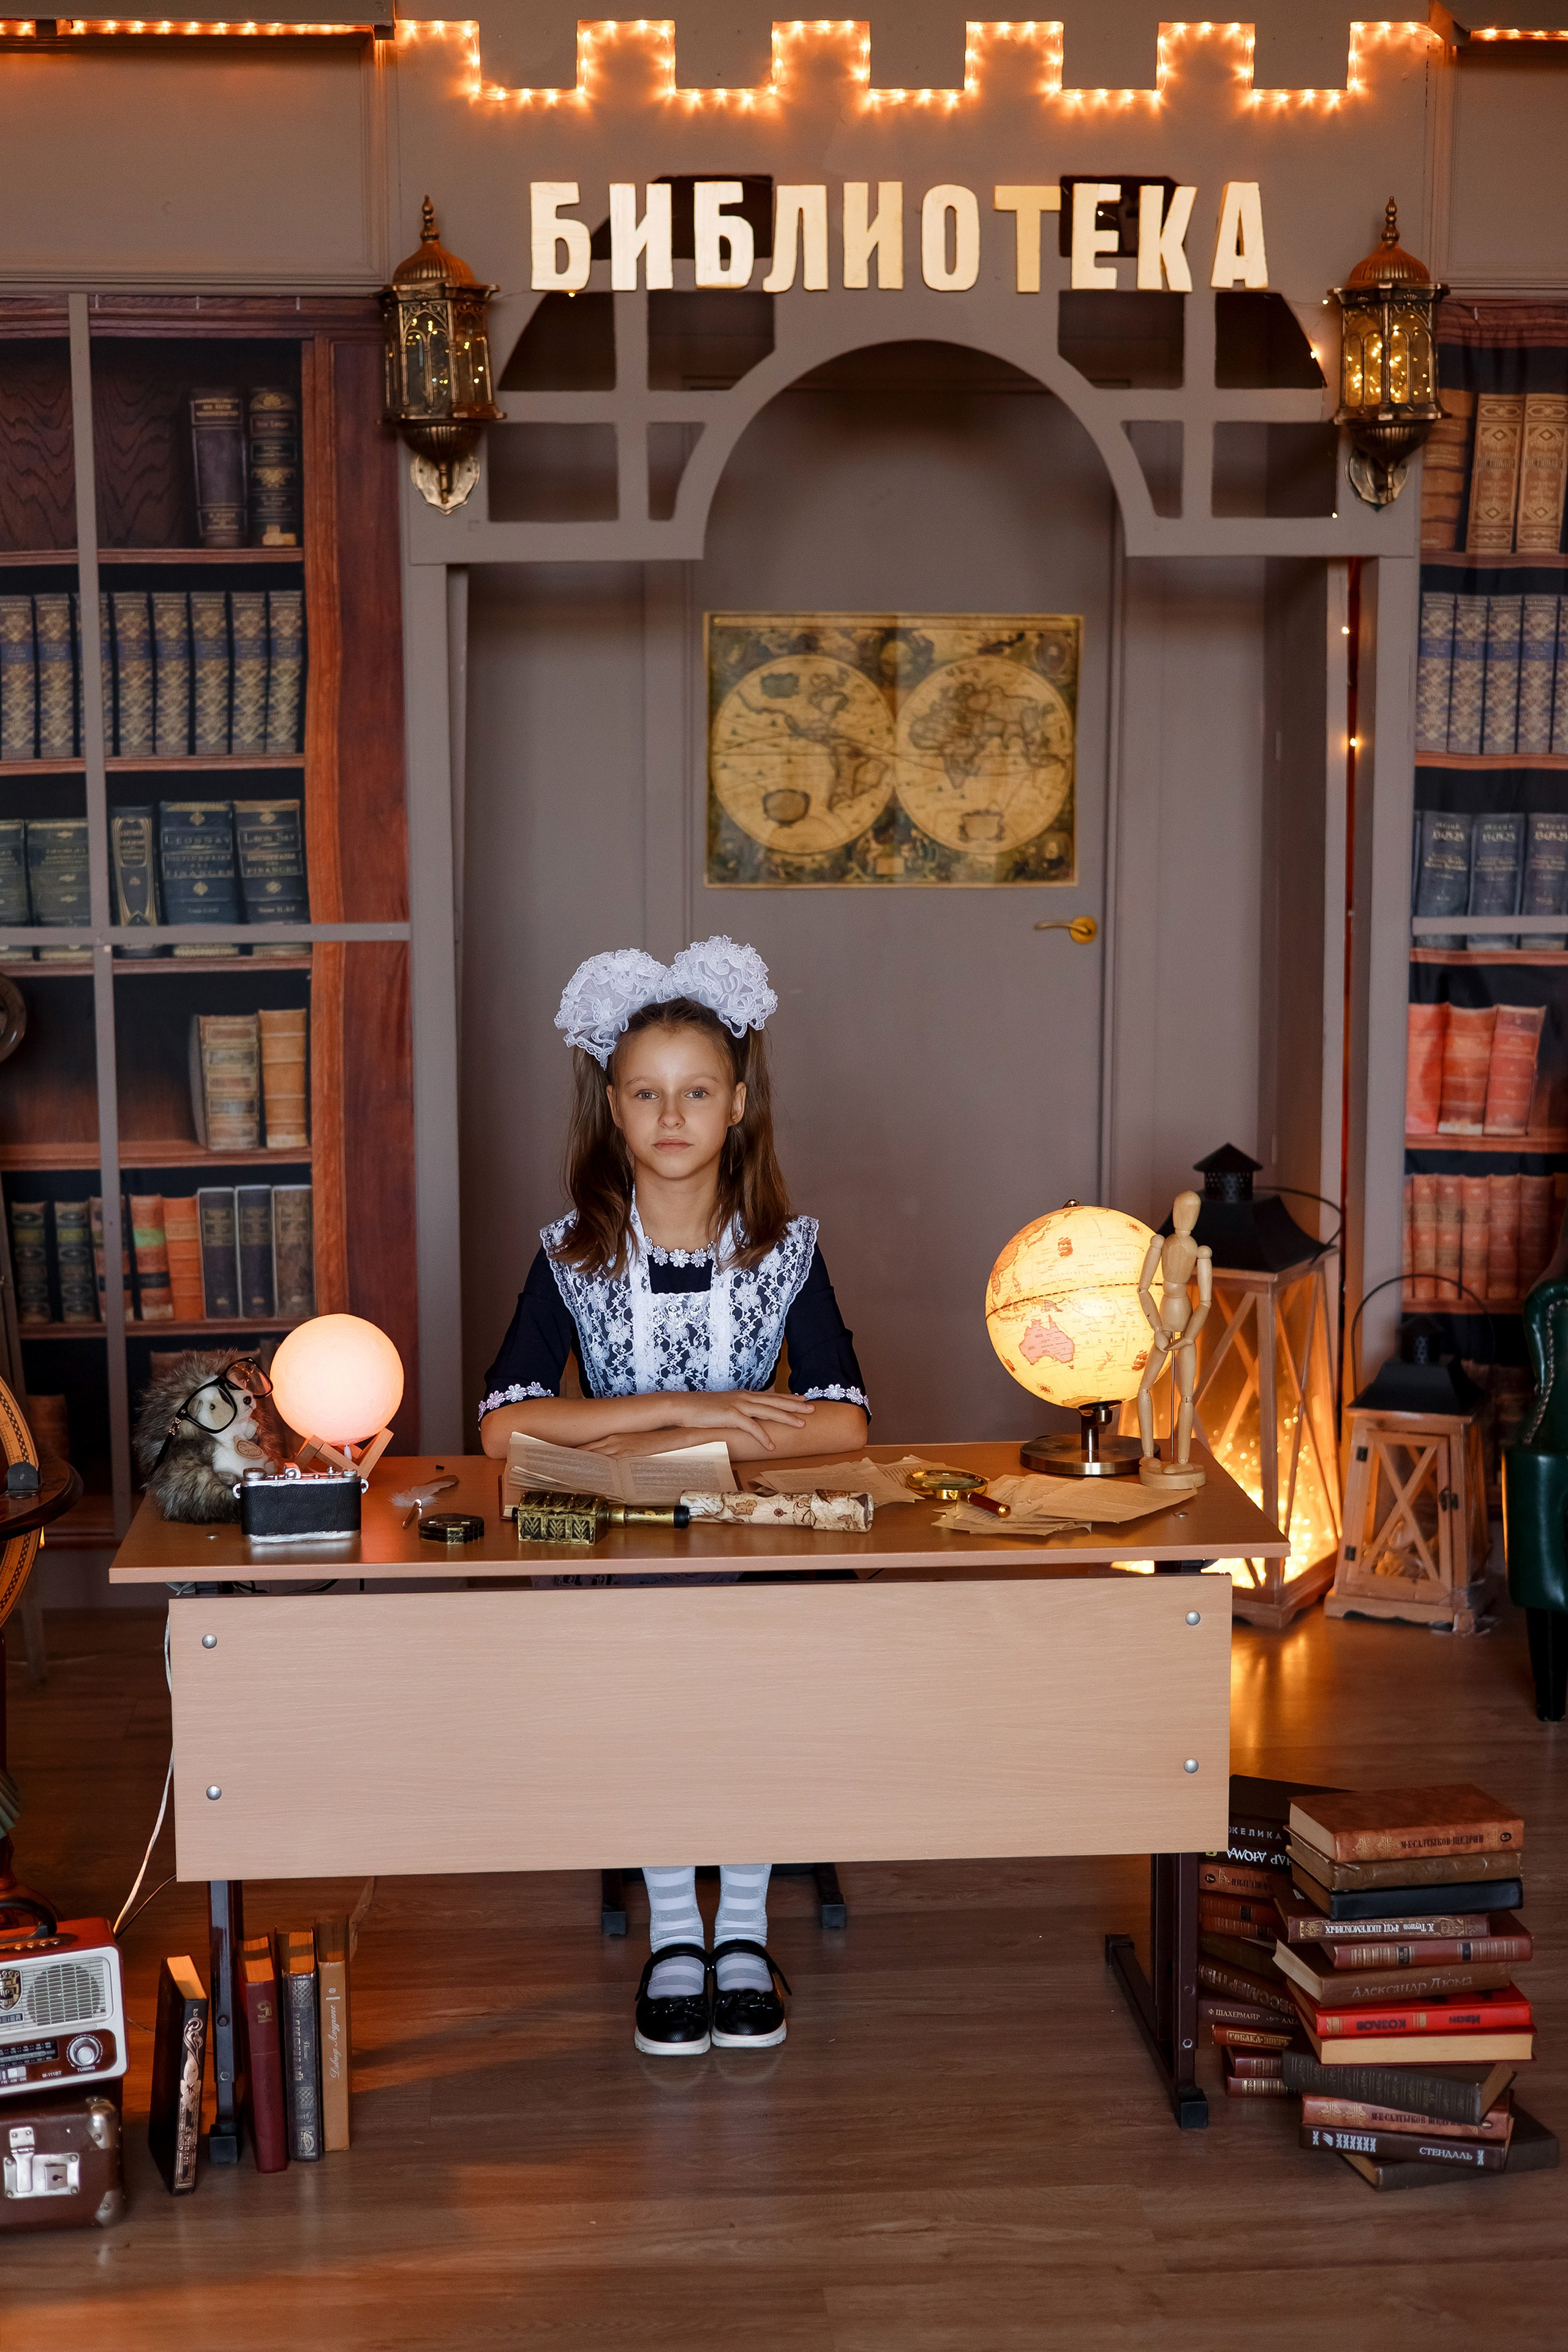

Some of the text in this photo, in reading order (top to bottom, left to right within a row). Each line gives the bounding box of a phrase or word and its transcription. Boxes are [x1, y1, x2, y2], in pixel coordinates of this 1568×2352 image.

[529, 181, 1268, 293] БИБЛИОТЕКА
[1229, 1826, 1282, 1840] ЖЕЛИКА
[1226, 1847, 1292, 1866] НДР ДЮМА
[1384, 1923, 1400, 1932] РОД
[1403, 1922, 1427, 1932] Теунов
[1199, 1964, 1295, 2015] БЕССМЕРТНЫ
[1351, 1977, 1472, 1999] Александр Дюма
[1420, 2146, 1473, 2160] СТЕНДАЛЬ
